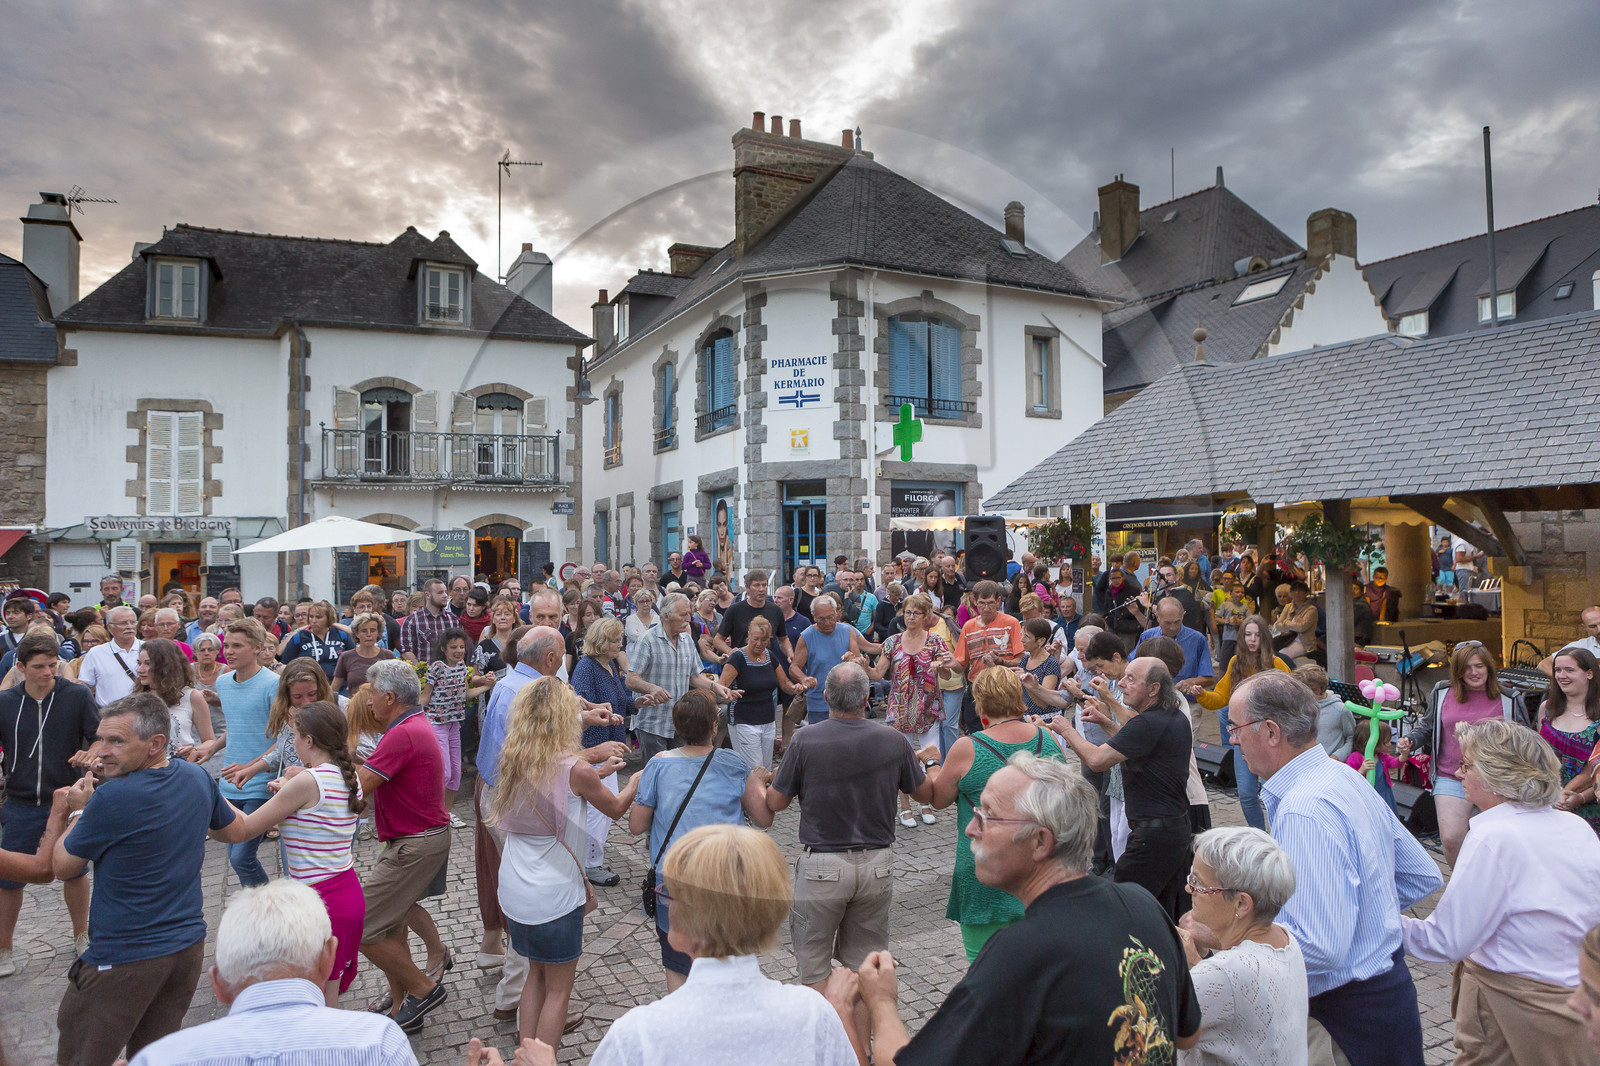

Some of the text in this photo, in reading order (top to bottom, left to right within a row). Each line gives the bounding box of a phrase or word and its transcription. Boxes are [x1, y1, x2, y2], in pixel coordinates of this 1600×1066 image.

[771, 355, 827, 368] PHARMACIE
[793, 368, 805, 378] DE
[774, 377, 825, 389] KERMARIO
[904, 494, 940, 502] FILORGA
[89, 516, 155, 530] Souvenirs
[174, 517, 231, 530] Bretagne
